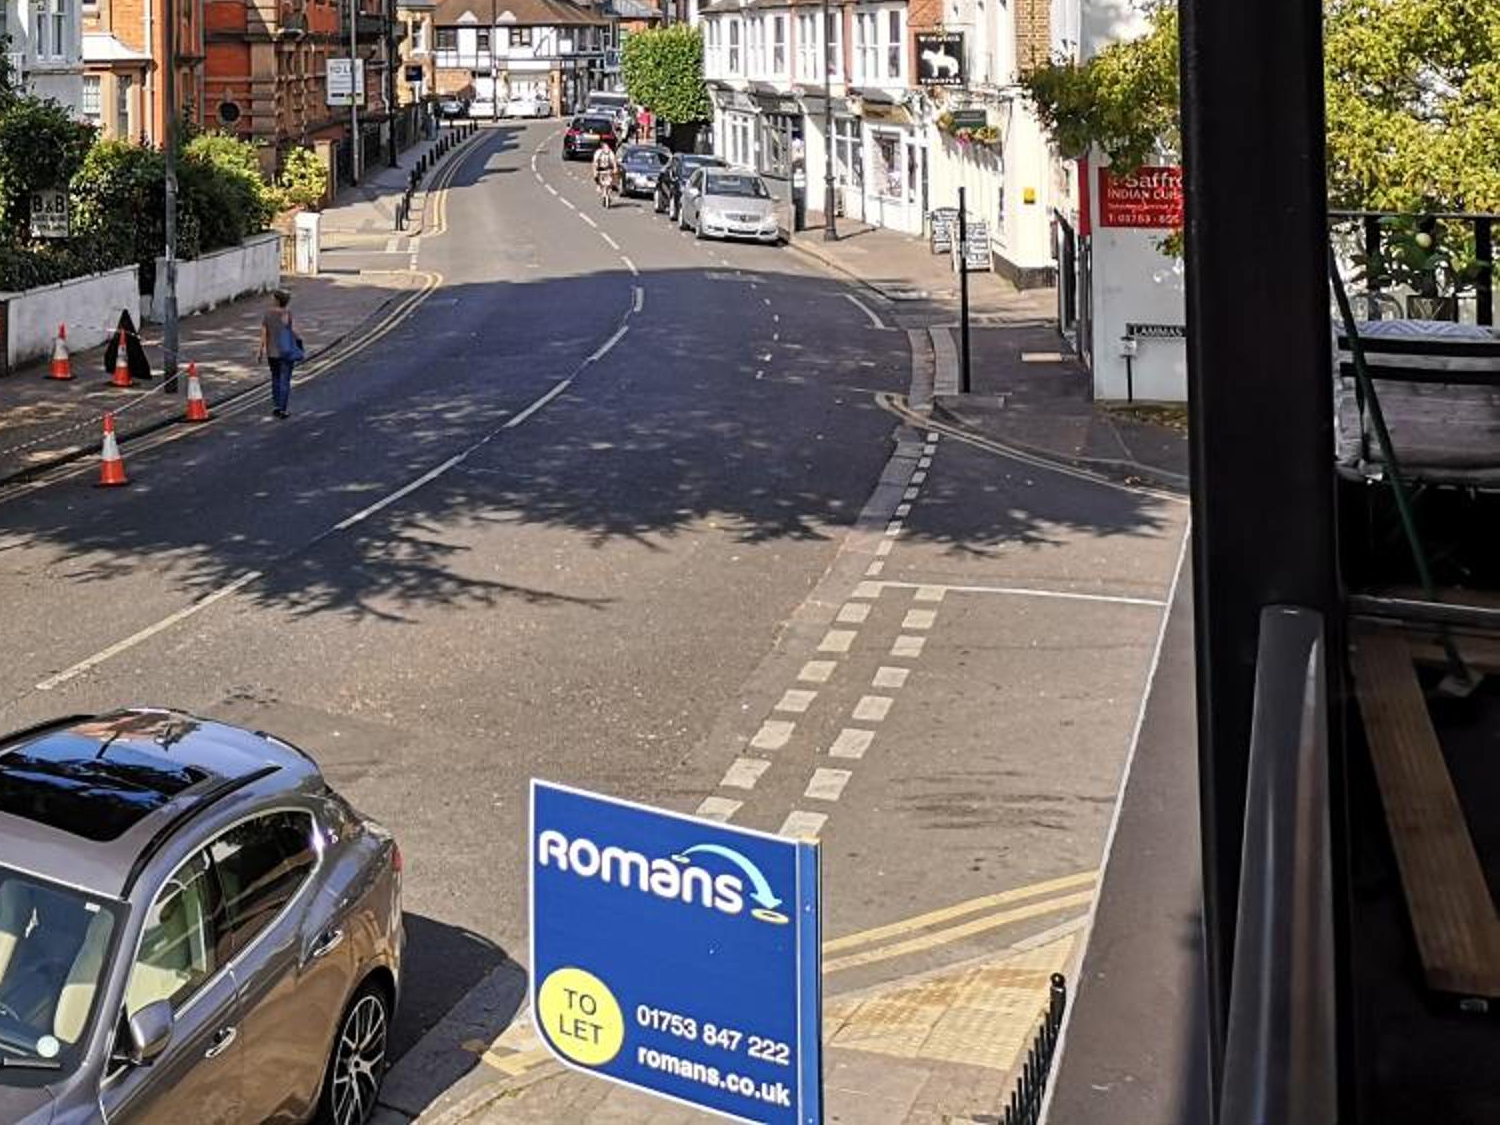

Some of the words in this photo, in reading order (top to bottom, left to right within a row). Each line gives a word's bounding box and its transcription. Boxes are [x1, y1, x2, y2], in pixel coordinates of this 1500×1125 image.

[1107, 188, 1150, 200] INDIAN
[563, 988, 597, 1016] TO
[560, 1013, 604, 1045] LET
[637, 1004, 698, 1040] 01753
[702, 1023, 743, 1052] 847
[747, 1035, 790, 1066] 222
[637, 1046, 791, 1107] romans.co.uk
